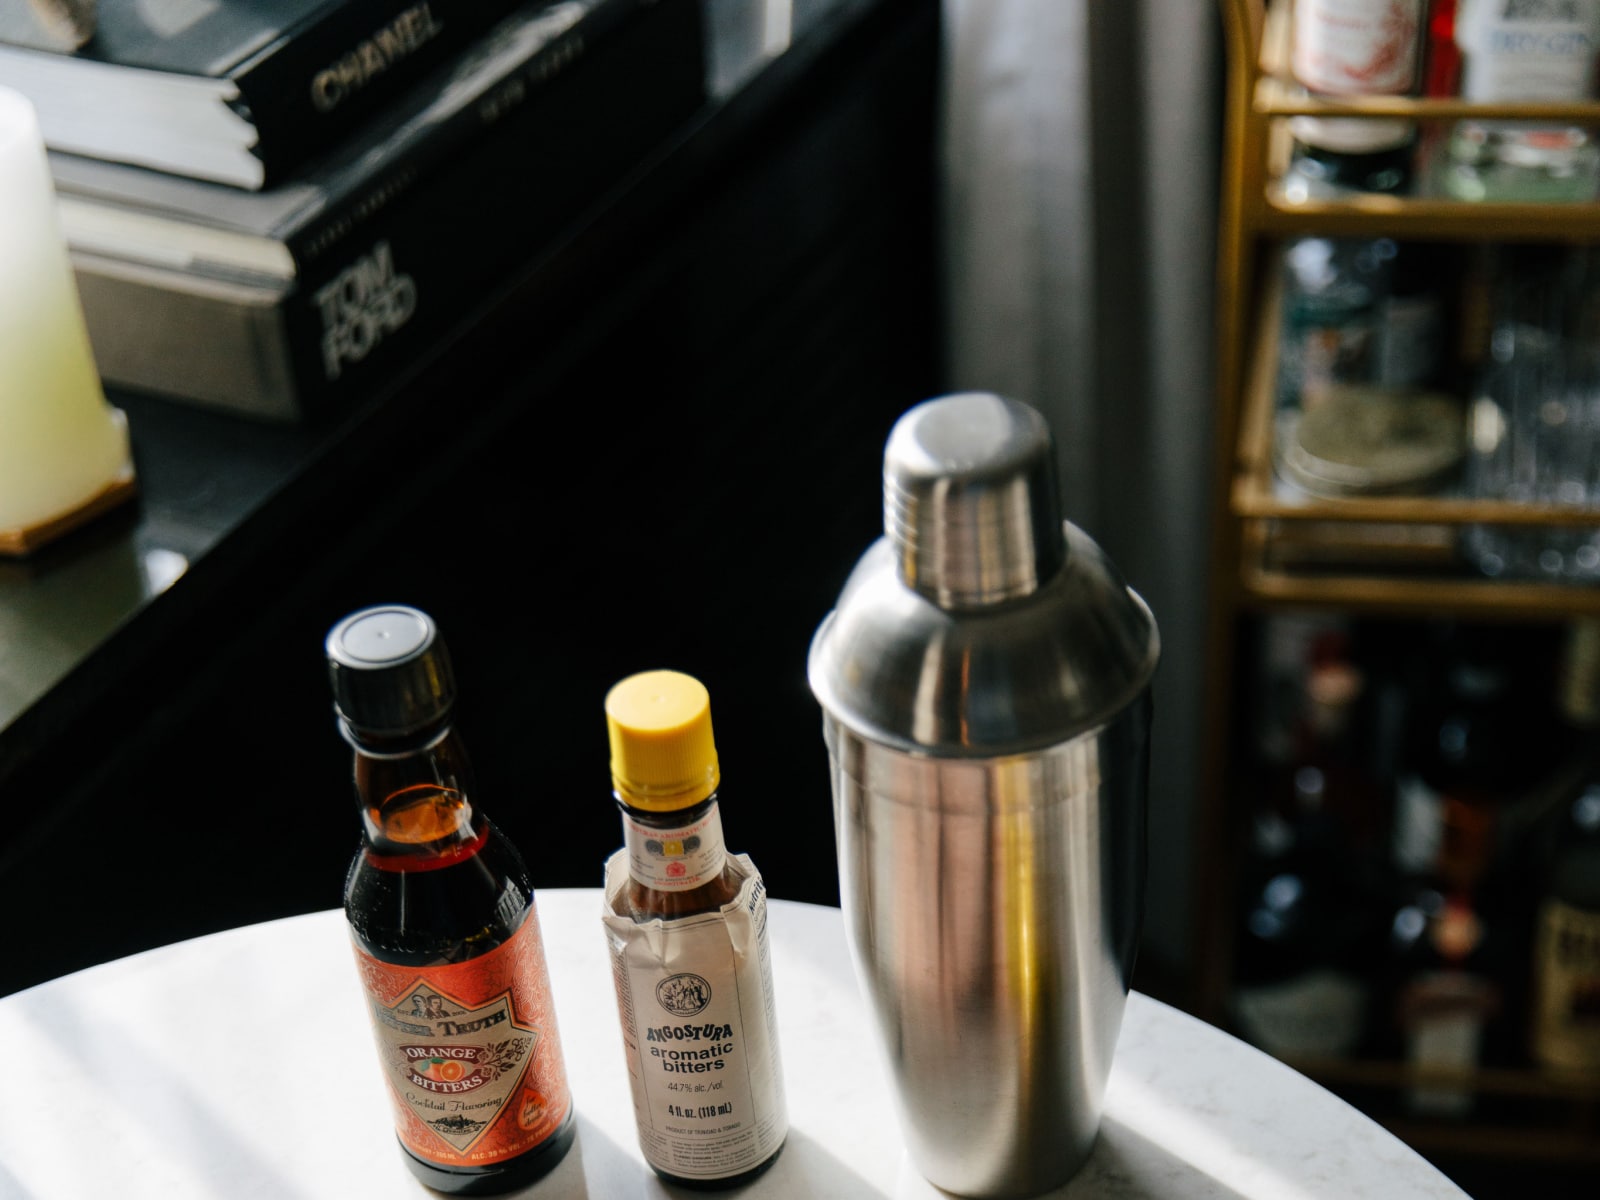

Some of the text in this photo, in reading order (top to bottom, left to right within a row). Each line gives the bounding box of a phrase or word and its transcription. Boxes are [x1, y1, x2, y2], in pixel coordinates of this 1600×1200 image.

[311, 2, 443, 111] CHANEL
[314, 241, 393, 327] TOM
[323, 275, 417, 379] FORD
[437, 1009, 507, 1036] TRUTH
[647, 1024, 733, 1042] ANGOSTURA
[407, 1048, 476, 1058] ORANGE
[650, 1043, 733, 1061] aromatic
[663, 1060, 725, 1073] bitters
[412, 1074, 483, 1093] BITTERS
[406, 1092, 502, 1111] Cocktail Flavoring
[669, 1105, 674, 1116] 4
[698, 1105, 716, 1119] (118
